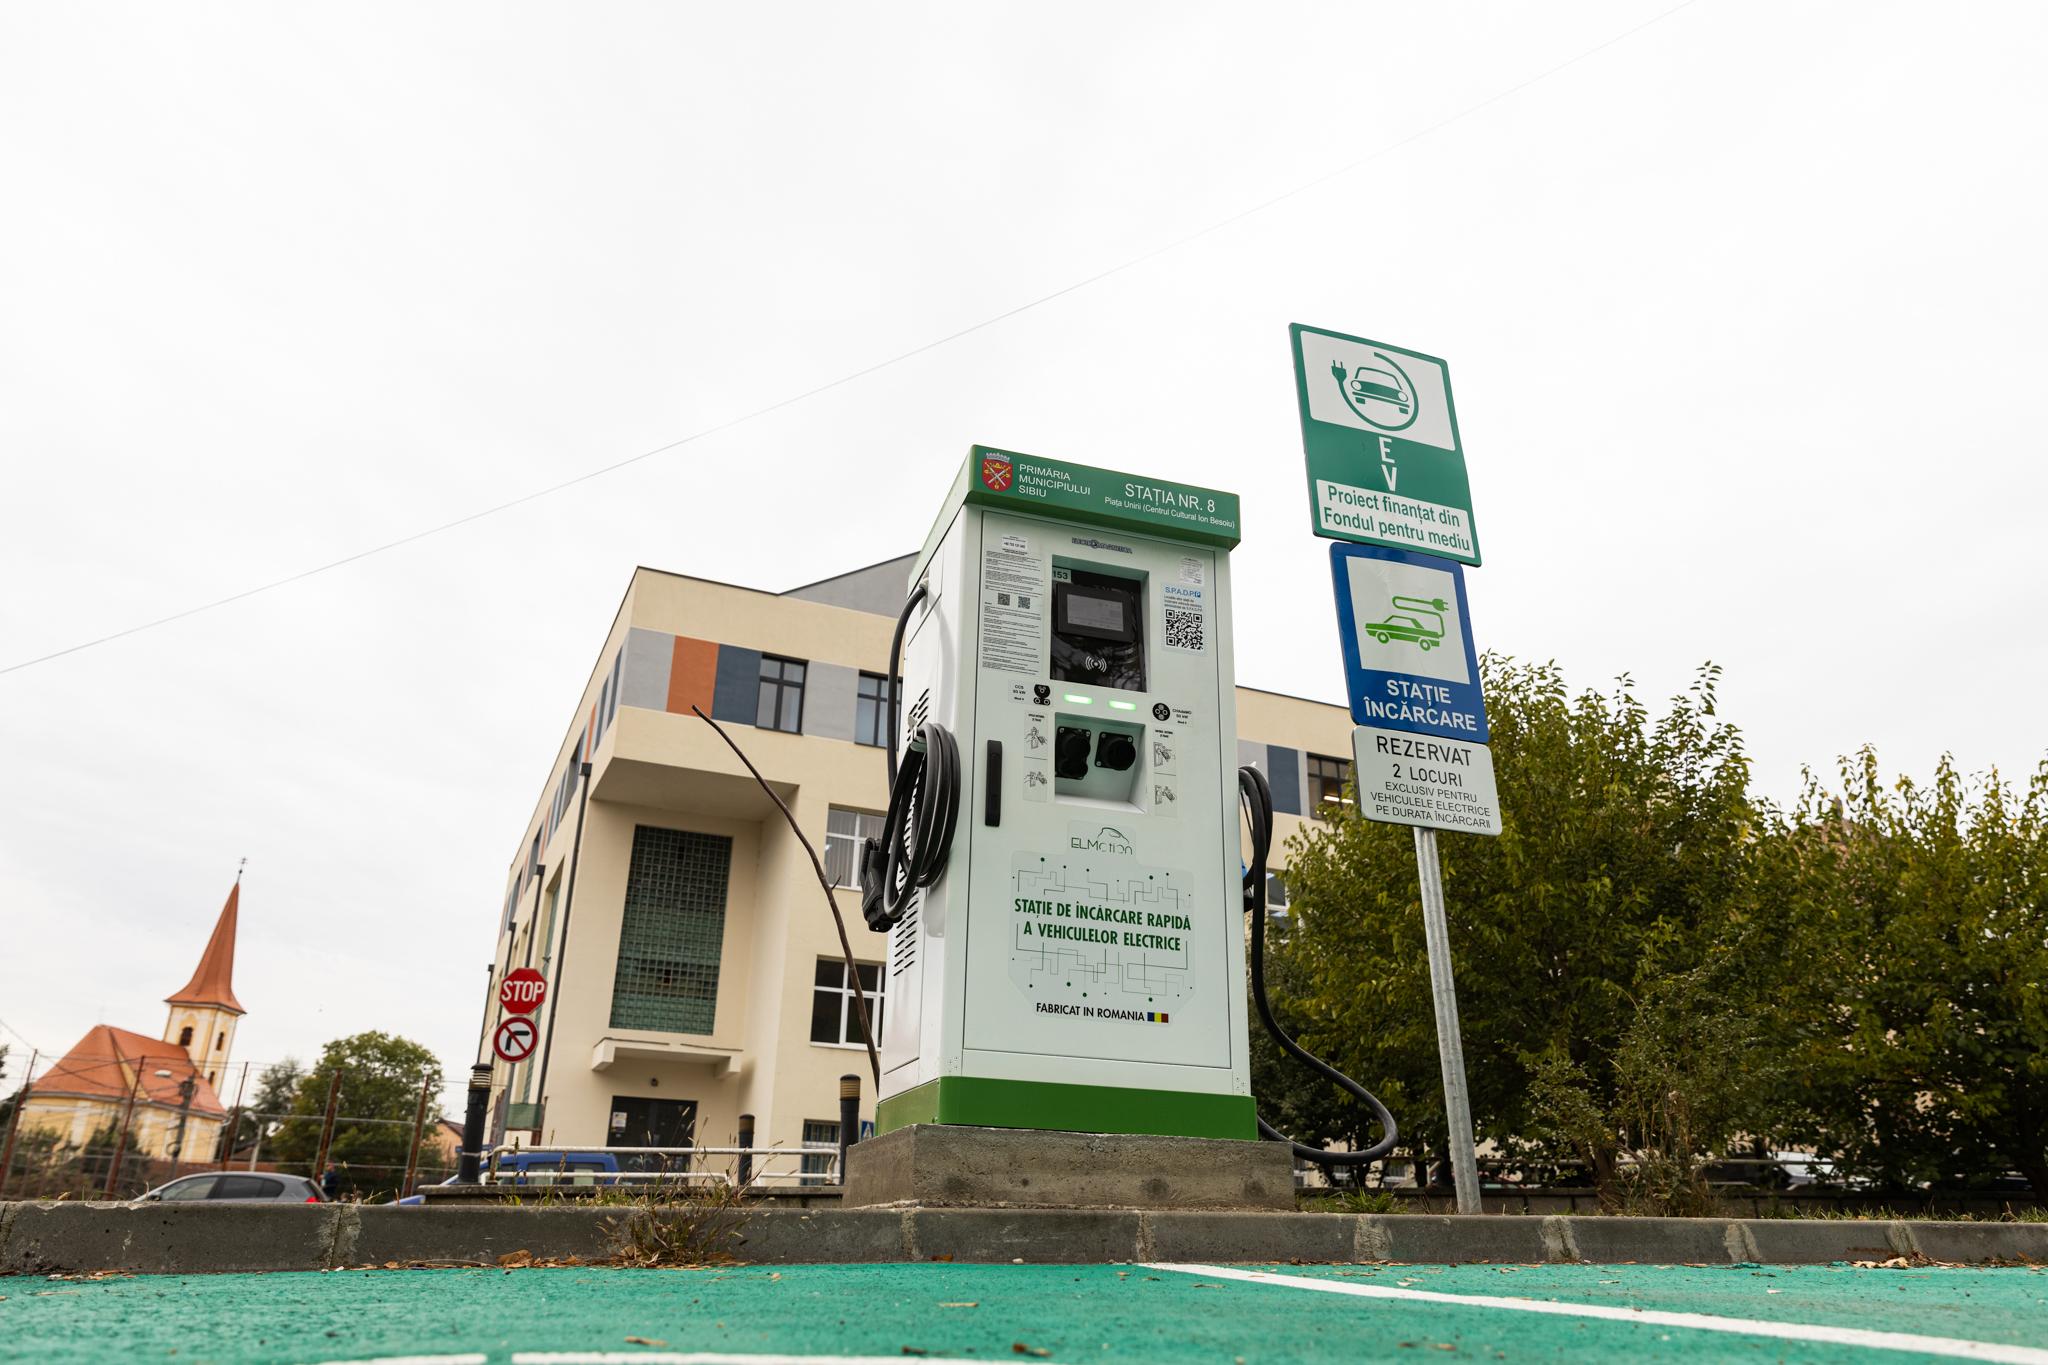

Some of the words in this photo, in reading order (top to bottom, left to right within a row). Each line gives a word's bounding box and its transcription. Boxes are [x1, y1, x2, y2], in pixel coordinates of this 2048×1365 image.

[1018, 474, 1091, 495] MUNICIPIULUI
[1019, 463, 1071, 481] PRIMĂRIA
[1018, 484, 1047, 498] SIBIU
[1124, 483, 1176, 507] STAȚIA
[1178, 493, 1203, 511] NR.
[1207, 499, 1216, 513] 8
[1104, 496, 1123, 508] Piața
[1124, 500, 1142, 510] Unirii
[1142, 503, 1170, 516] (Centrul
[1171, 509, 1197, 521] Cultural
[1198, 514, 1209, 523] Ion
[1209, 516, 1235, 529] Besoiu)
[1327, 485, 1380, 511] Proiect
[1382, 496, 1436, 524] finanțat
[1439, 509, 1461, 528] din
[1323, 506, 1375, 532] Fondul
[1378, 522, 1425, 542] pentru
[1428, 529, 1471, 552] mediu
[1386, 679, 1452, 706] STAȚIE
[1363, 696, 1478, 732] ÎNCĂRCARE
[1376, 735, 1472, 767] REZERVAT
[1392, 763, 1402, 778] 2
[1409, 766, 1463, 788] LOCURI
[1370, 791, 1434, 809] VEHICULELE
[1436, 800, 1491, 817] ELECTRICE
[1385, 781, 1435, 797] EXCLUSIV
[1437, 788, 1478, 803] PENTRU
[1375, 804, 1390, 815] PE
[1392, 806, 1433, 821] DURATA
[1435, 810, 1491, 828] ÎNCĂRCARII
[1014, 898, 1053, 918] STAȚIE
[1056, 902, 1072, 918] DE
[1075, 901, 1143, 926] ÎNCĂRCARE
[1146, 912, 1192, 931] RAPIDĂ
[1023, 921, 1033, 936] A
[1037, 922, 1118, 945] VEHICULELOR
[1123, 931, 1181, 951] ELECTRICE
[501, 980, 545, 1002] STOP
[1036, 1002, 1081, 1017] FABRICAT
[1083, 1006, 1095, 1017] IN
[1097, 1007, 1146, 1022] ROMANIA
